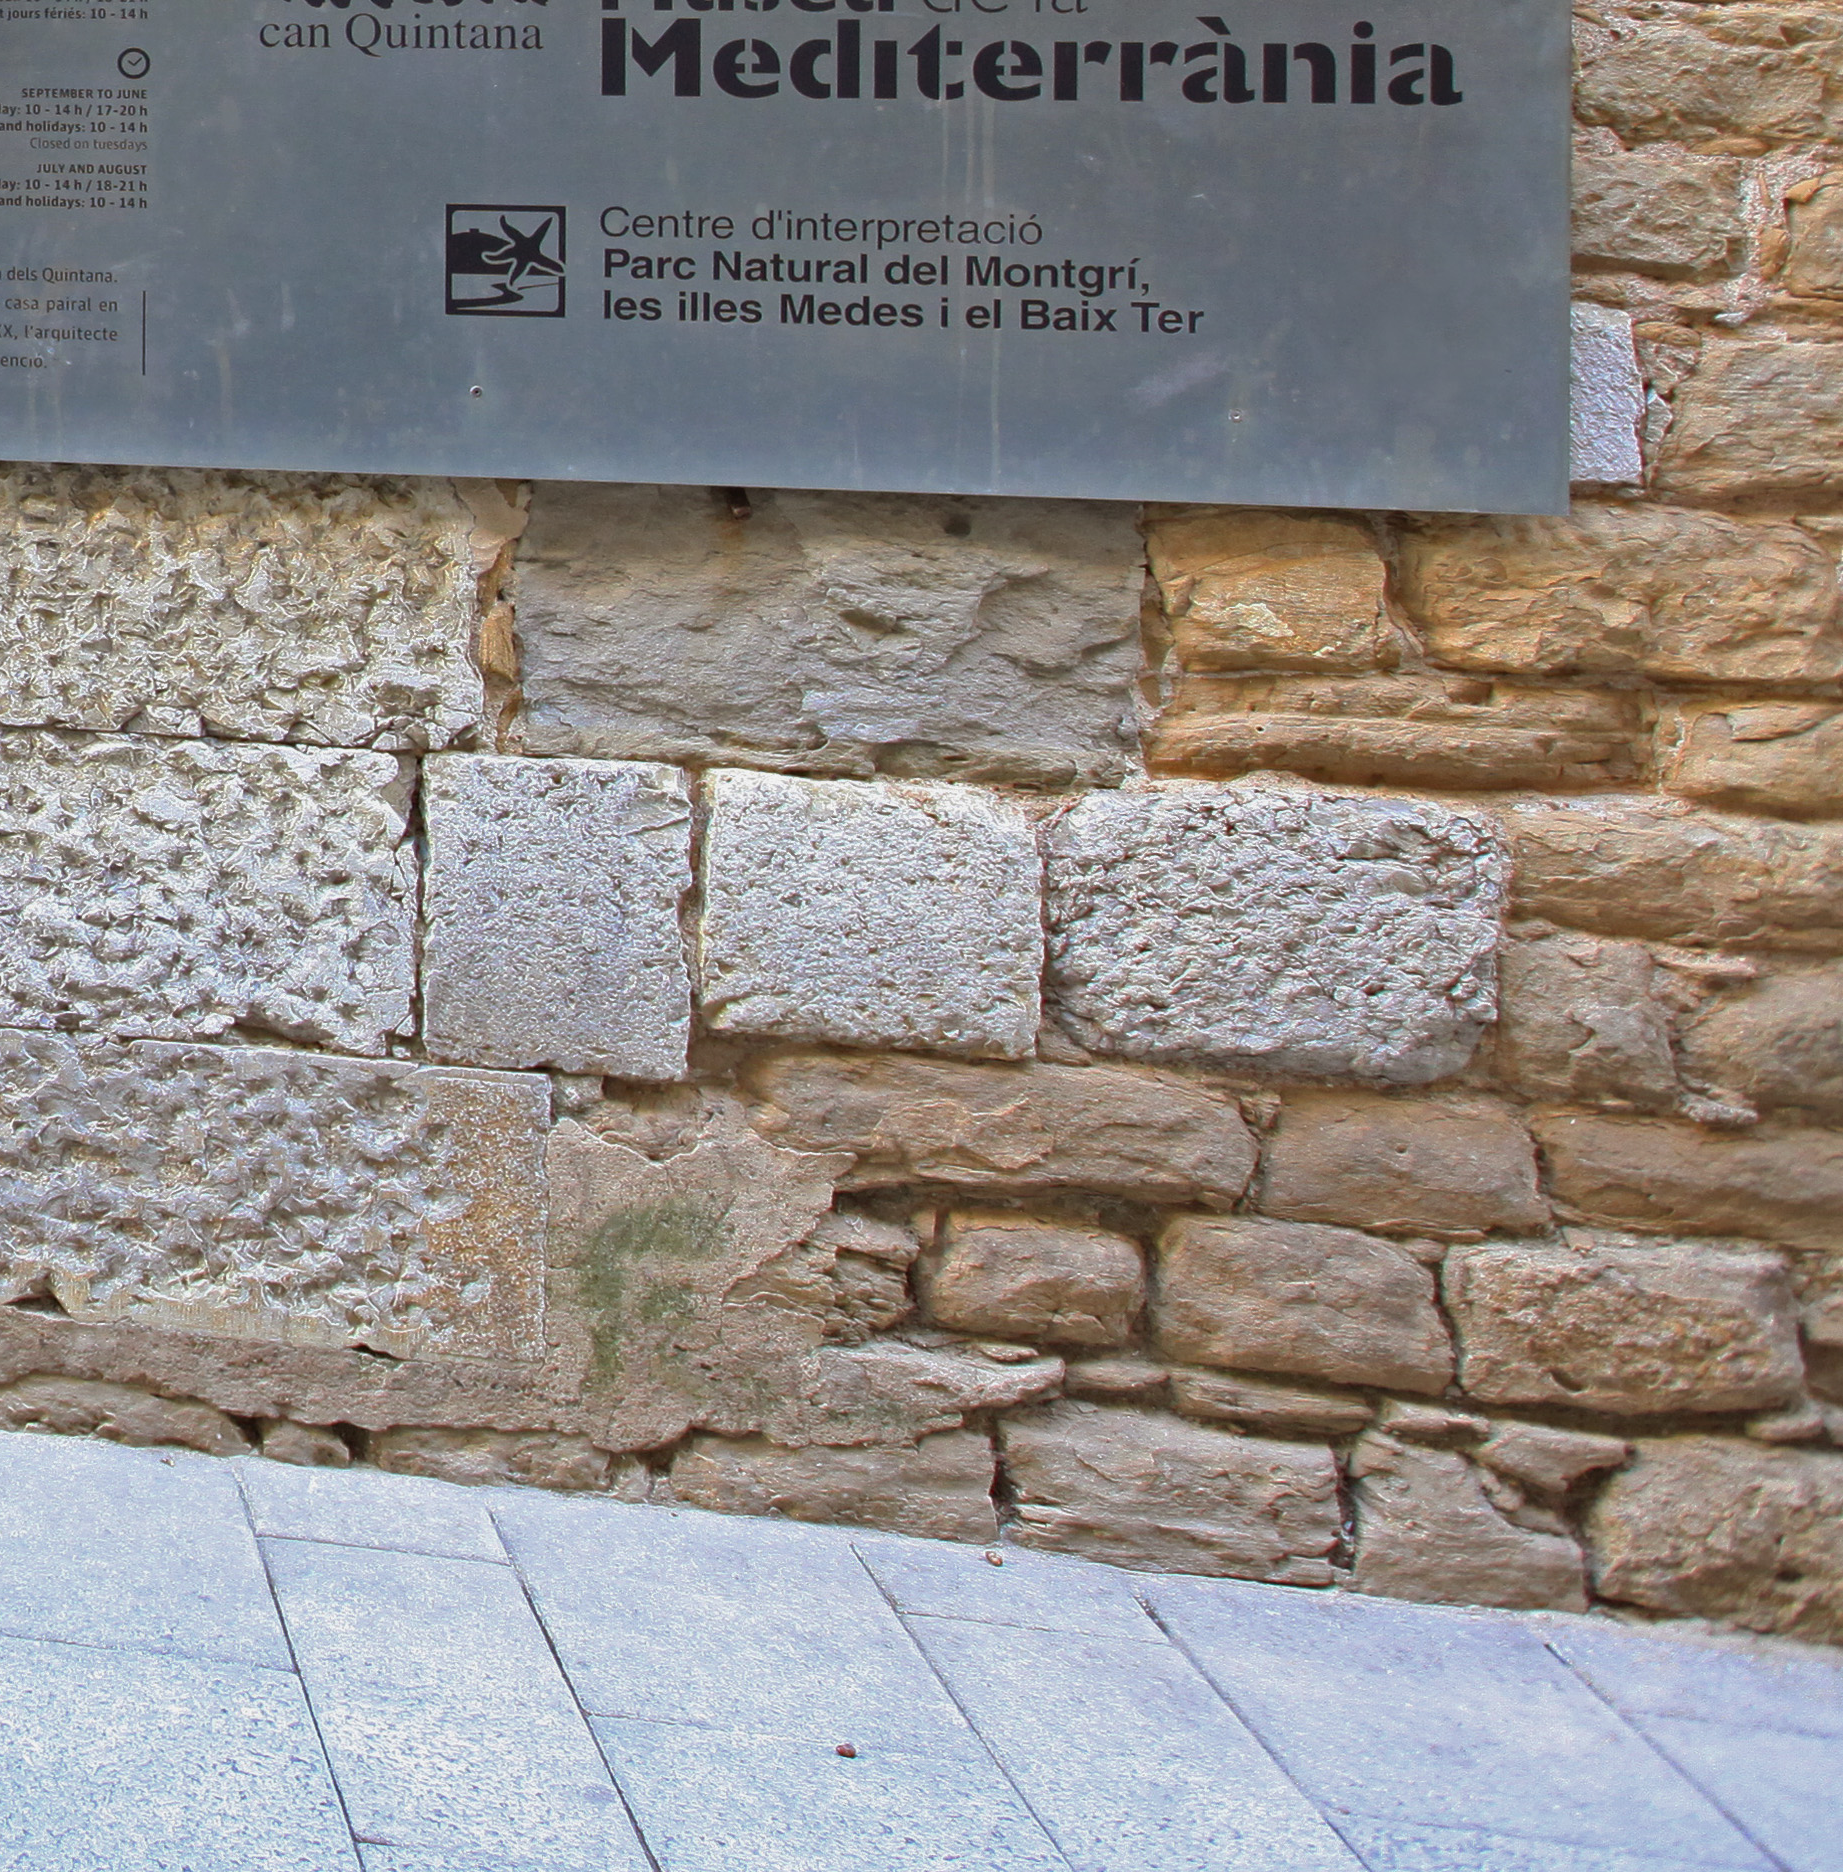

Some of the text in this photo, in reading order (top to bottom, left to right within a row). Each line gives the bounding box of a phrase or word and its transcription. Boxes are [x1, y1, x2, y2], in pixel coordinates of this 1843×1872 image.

[259, 13, 544, 58] can Quintana
[601, 16, 1464, 106] Mediterrània
[21, 88, 148, 99] SEPTEMBER TO JUNE
[30, 137, 148, 152] Closed on tuesdays
[36, 164, 148, 175] JULY AND AUGUST
[600, 206, 1043, 250] Centre d'interpretació
[6, 266, 38, 281] dels
[42, 267, 118, 284] Quintana.
[602, 249, 1151, 297] Parc Natural del Montgrí,
[5, 299, 39, 310] casa
[46, 297, 91, 313] pairal
[99, 301, 118, 312] en
[602, 290, 1205, 334] les illes Medes i el Baix Ter
[24, 325, 118, 342] l'arquitecte
